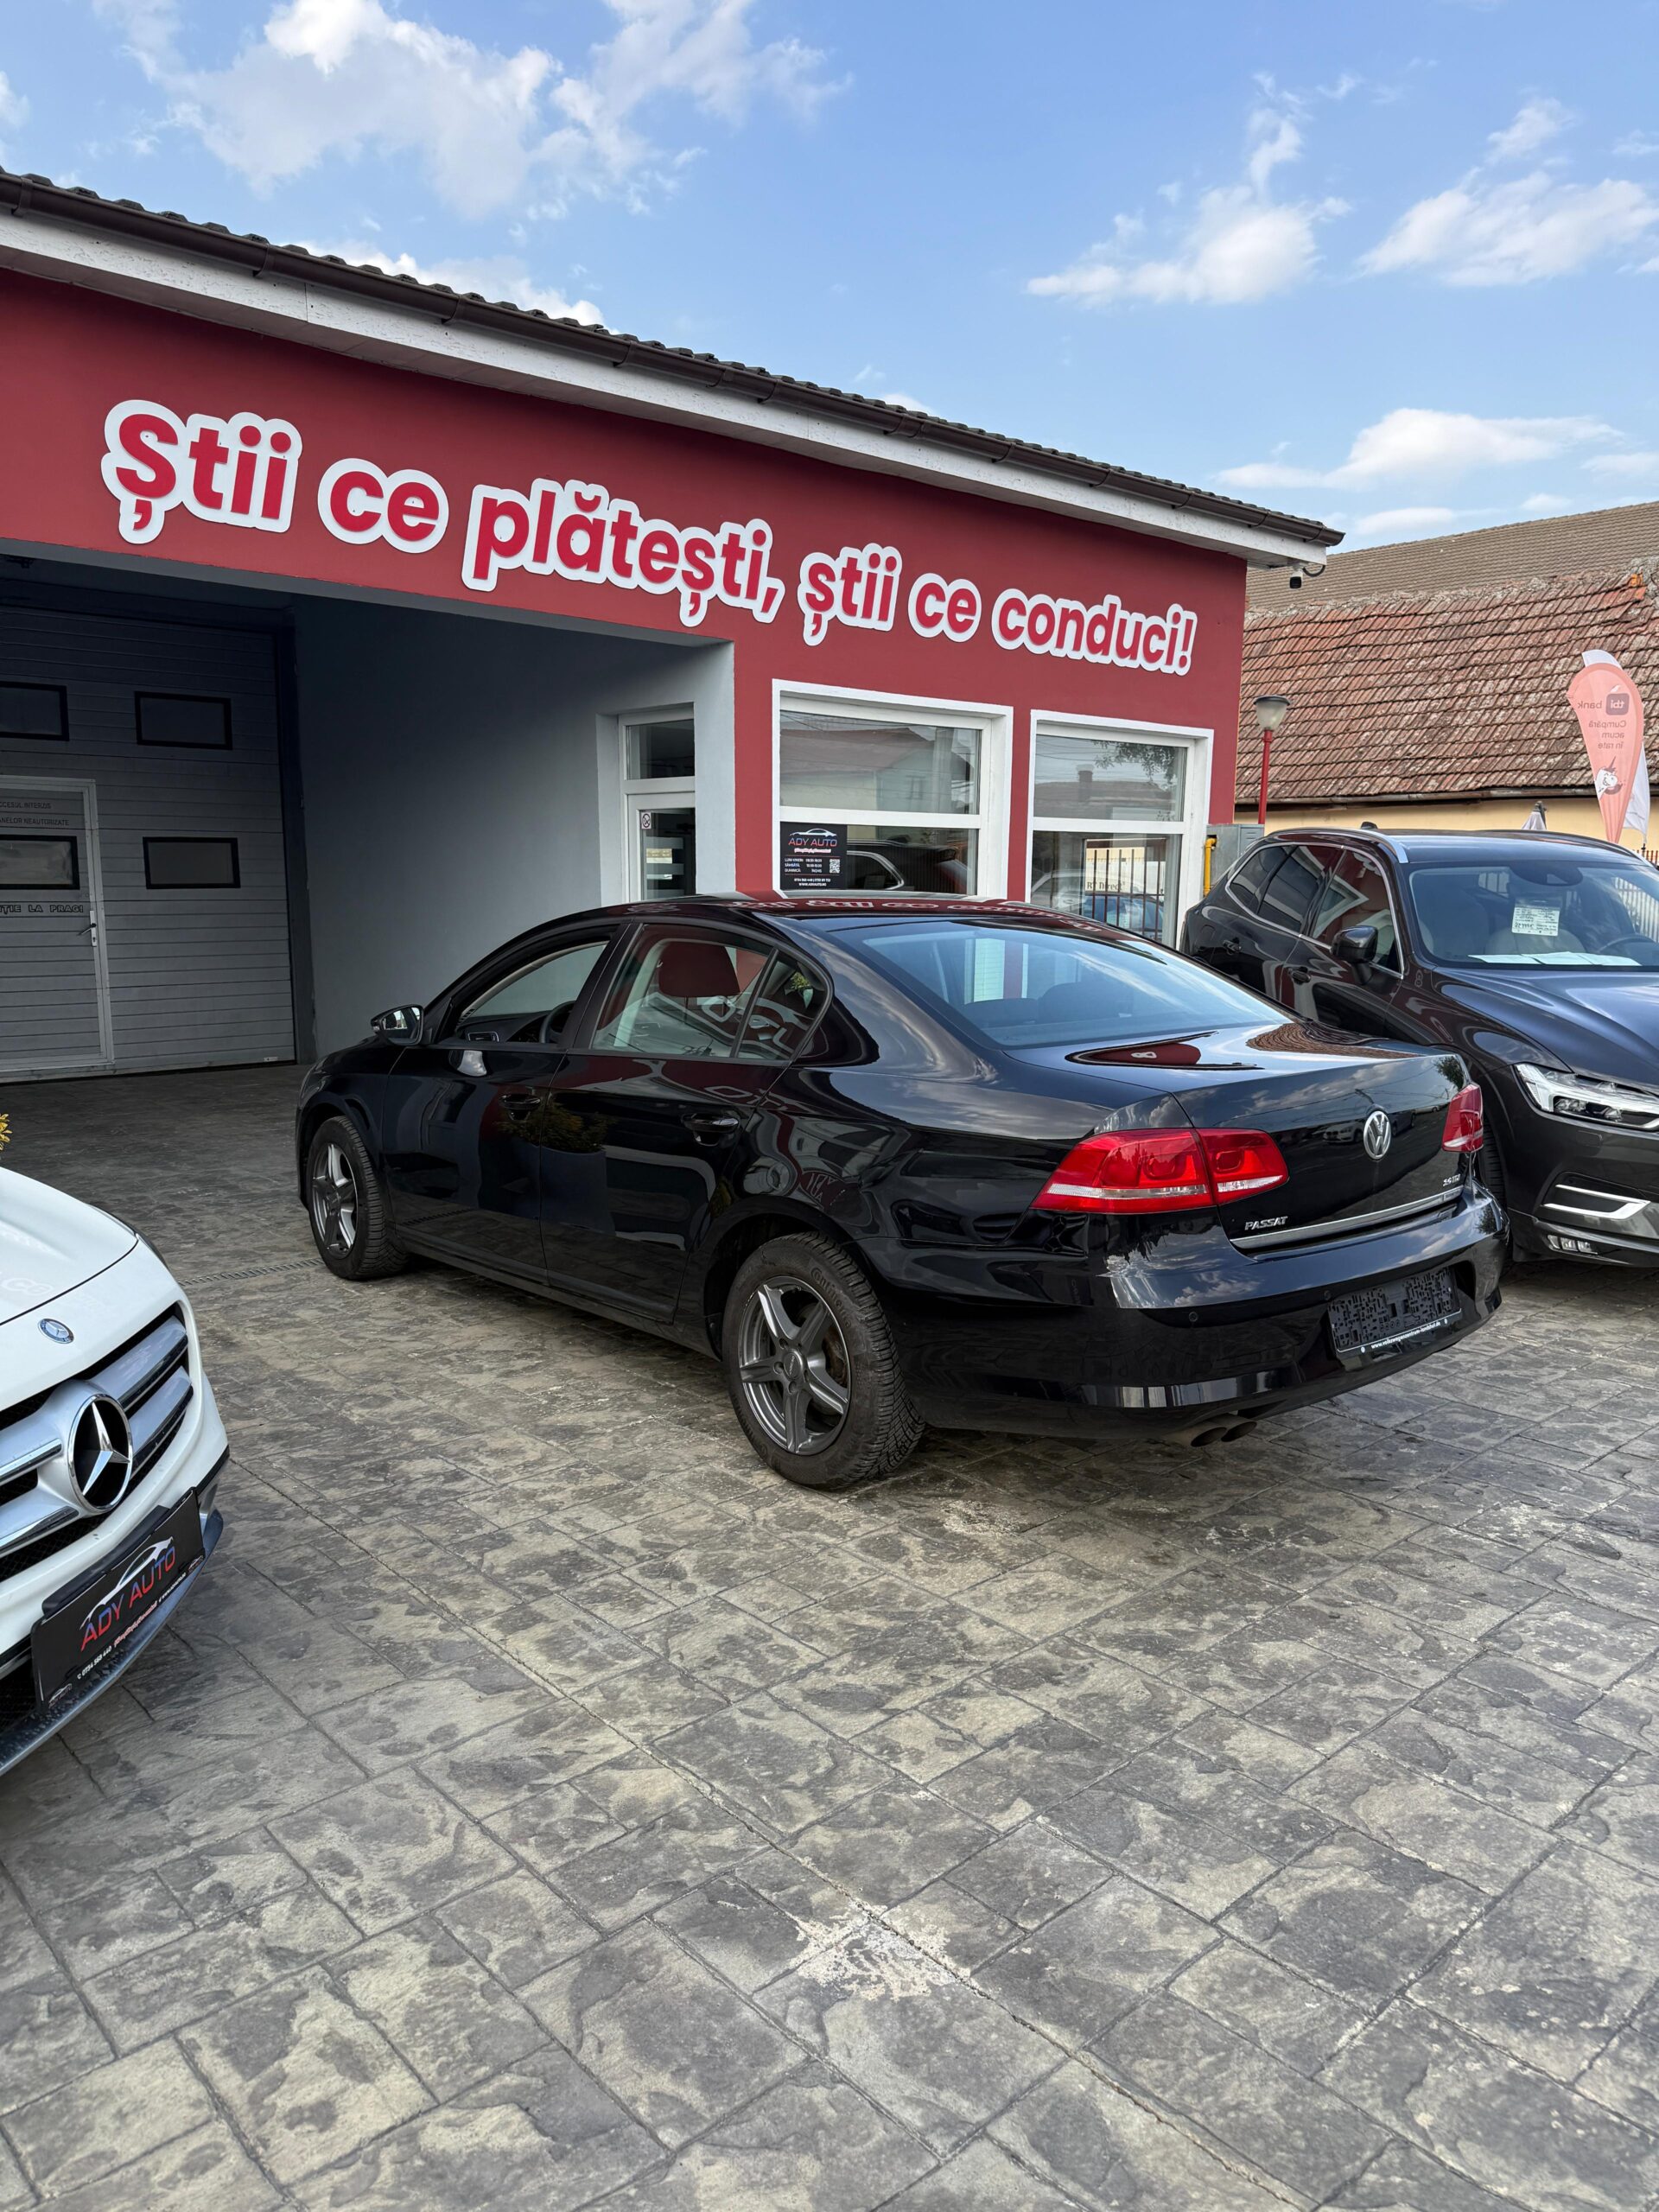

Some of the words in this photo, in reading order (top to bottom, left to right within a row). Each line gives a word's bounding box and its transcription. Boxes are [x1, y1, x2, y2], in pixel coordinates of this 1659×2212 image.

[113, 411, 293, 532] Știi
[327, 468, 442, 543] ce
[470, 489, 781, 619] plătești,
[803, 550, 899, 639] știi
[913, 580, 978, 635] ce
[997, 600, 1196, 671] conduci!
[788, 837, 809, 846] ADY
[810, 838, 837, 847] AUTO
[28, 904, 43, 913] LA
[49, 904, 84, 913] PRAGI
[1244, 1216, 1288, 1231] PASSAT
[80, 1593, 124, 1652] ADY
[129, 1545, 176, 1609] AUTO
